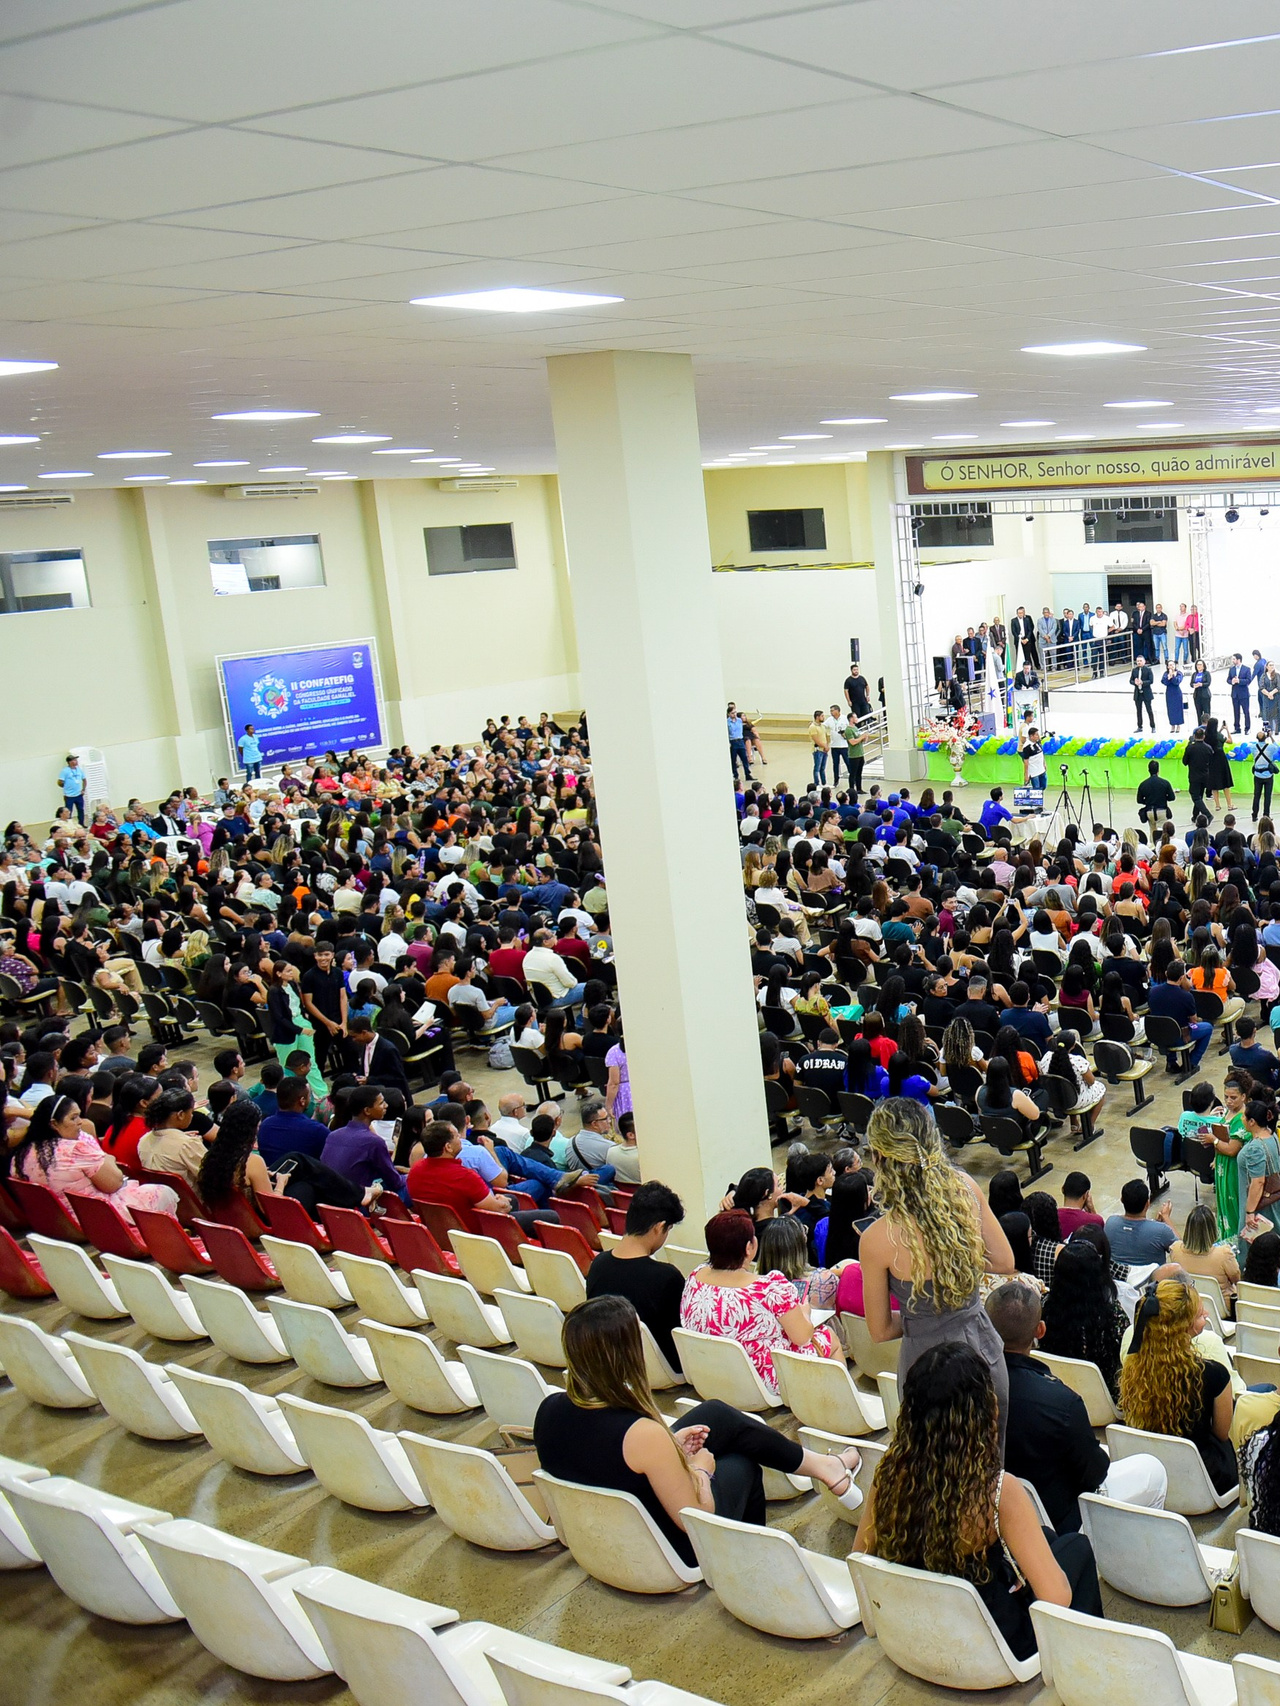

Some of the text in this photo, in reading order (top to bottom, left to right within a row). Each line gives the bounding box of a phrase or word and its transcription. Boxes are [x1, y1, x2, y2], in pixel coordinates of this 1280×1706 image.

[940, 461, 954, 481] Ó
[959, 463, 1033, 481] SENHOR,
[1037, 460, 1092, 478] Senhor
[1096, 461, 1146, 476] nosso,
[1150, 456, 1190, 477] quão
[1195, 451, 1275, 471] admirável
[290, 675, 354, 690] II CONFATEFIG
